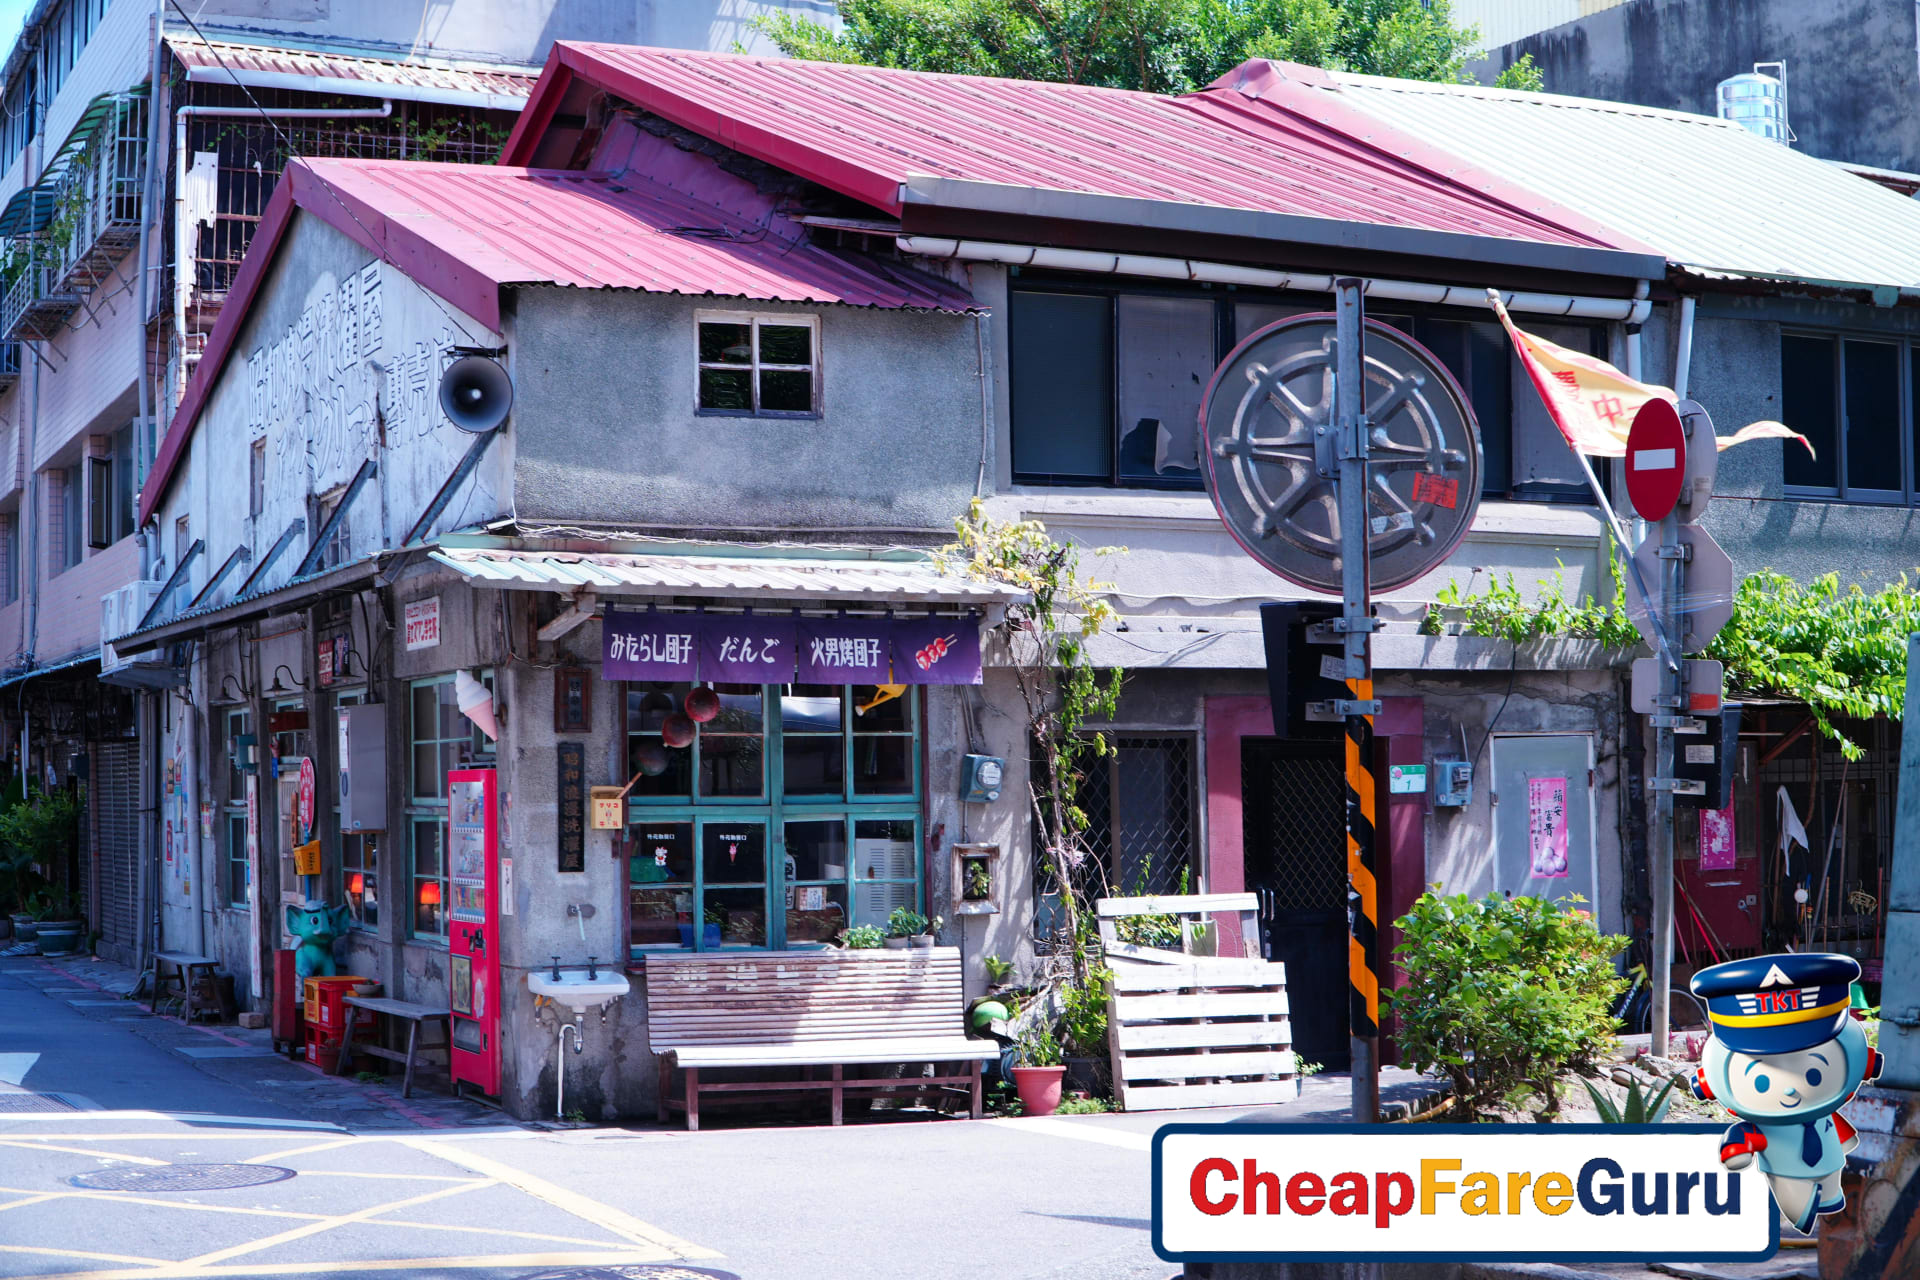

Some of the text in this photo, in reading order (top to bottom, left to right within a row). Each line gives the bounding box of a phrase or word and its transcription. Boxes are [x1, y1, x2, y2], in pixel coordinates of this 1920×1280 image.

[610, 633, 693, 665] みたらし団子
[719, 635, 780, 664] だんご
